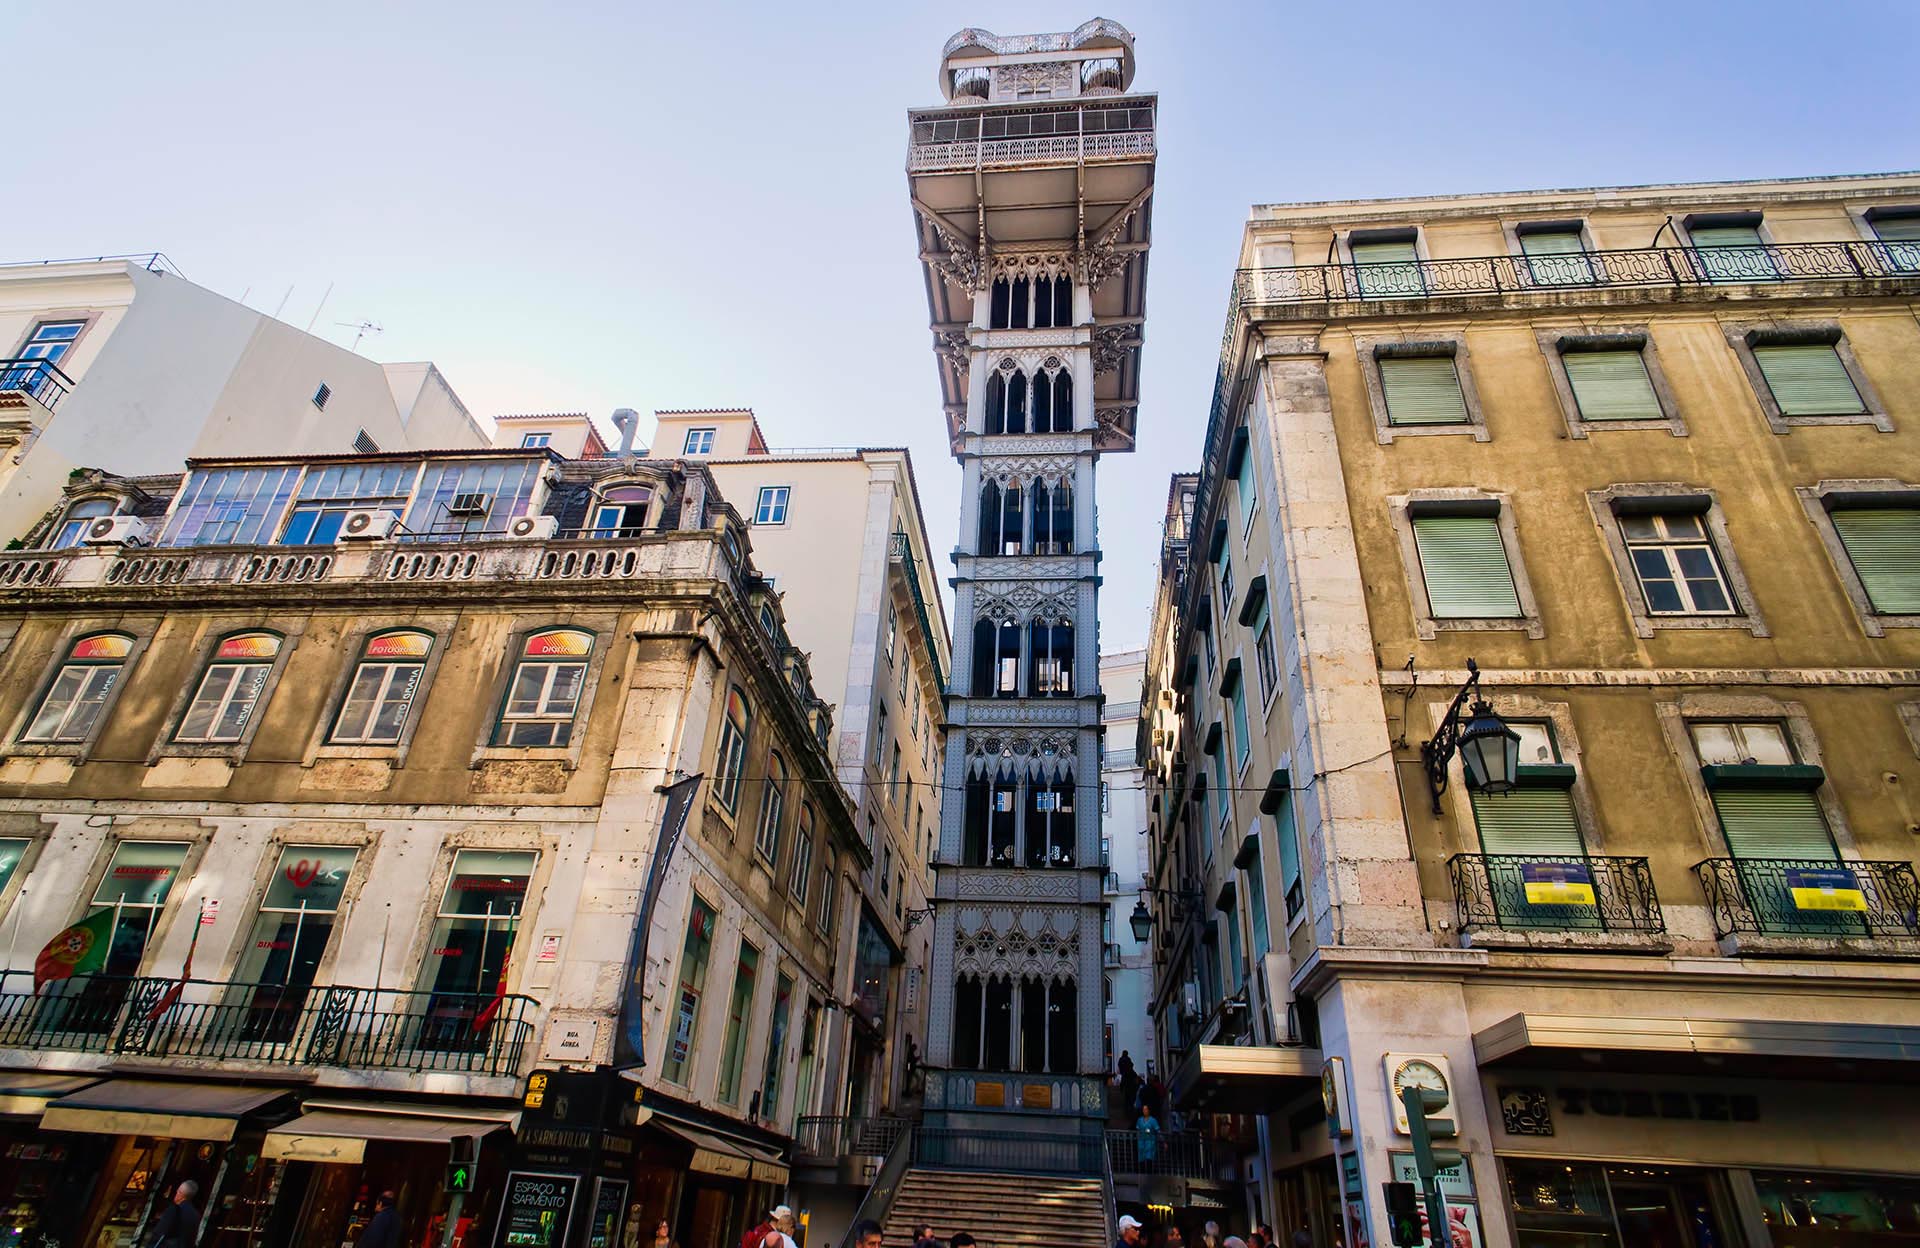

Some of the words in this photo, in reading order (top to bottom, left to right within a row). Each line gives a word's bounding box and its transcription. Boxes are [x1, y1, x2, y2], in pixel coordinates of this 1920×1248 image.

[371, 646, 420, 654] FOTOGRA
[97, 674, 116, 700] FILMES
[567, 668, 583, 699] DIGITAL
[560, 1040, 580, 1048] ÁUREA
[1556, 1088, 1761, 1121] TORRES
[514, 1182, 555, 1196] ESPAÇO
[512, 1193, 566, 1208] SARMENTO
